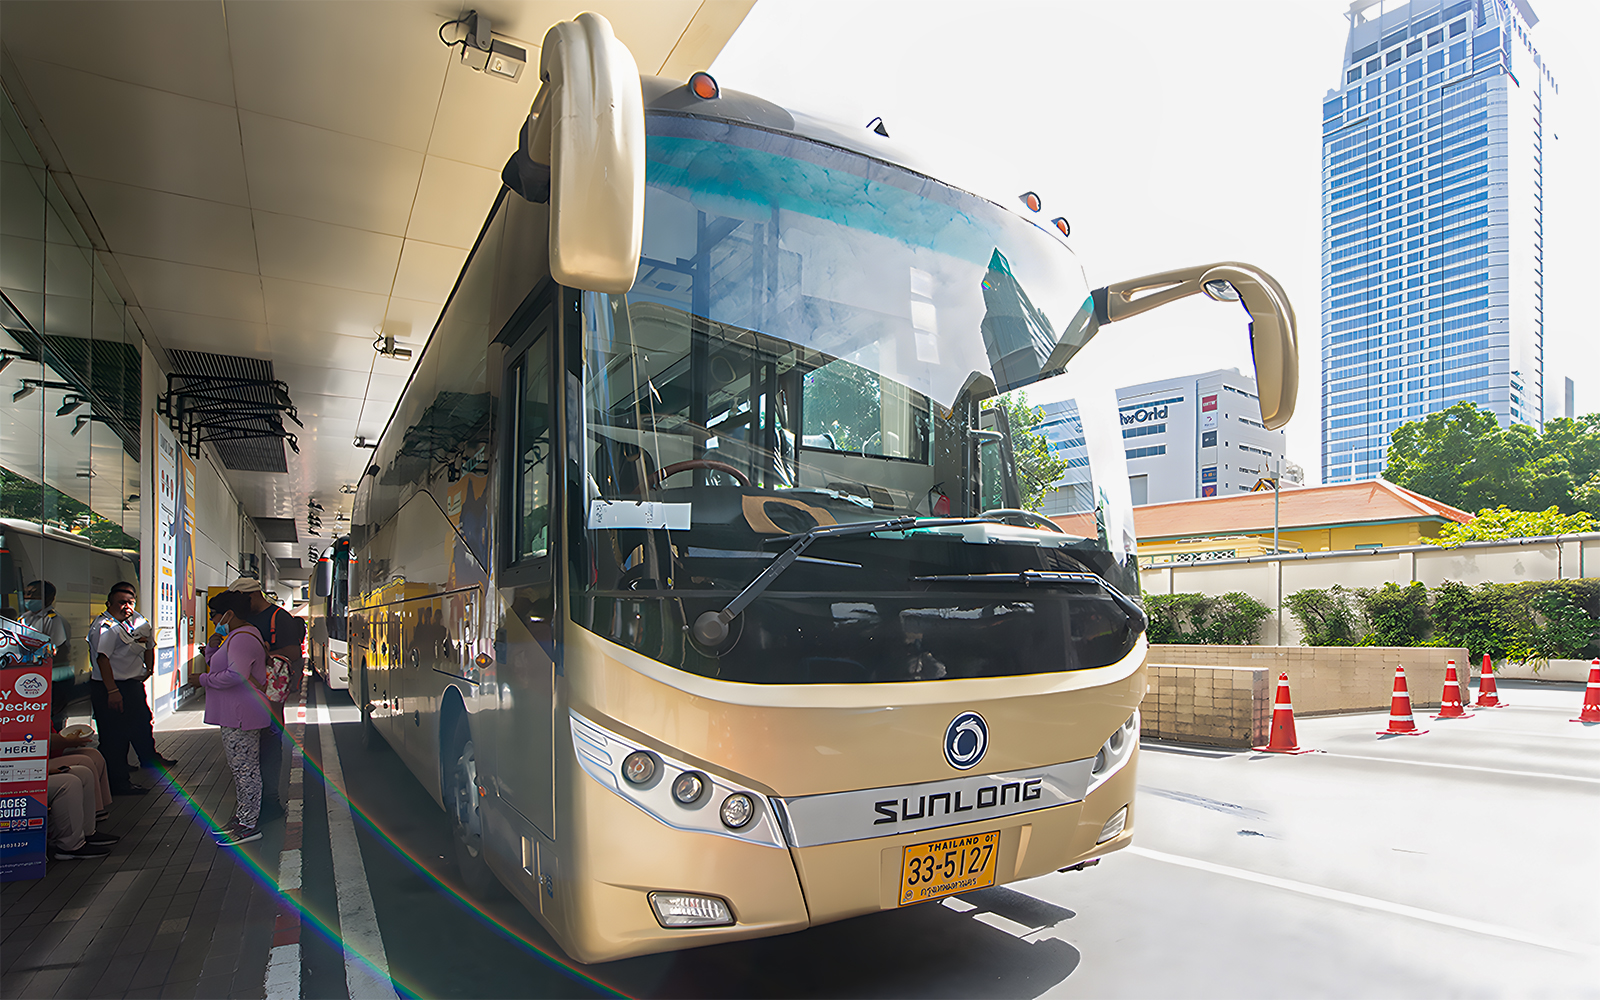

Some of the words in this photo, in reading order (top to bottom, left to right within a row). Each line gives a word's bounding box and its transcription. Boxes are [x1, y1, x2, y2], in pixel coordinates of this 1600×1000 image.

[4, 745, 36, 754] HERE
[873, 778, 1042, 825] SUNLONG
[928, 837, 980, 852] THAILAND
[908, 844, 994, 885] 33-5127
